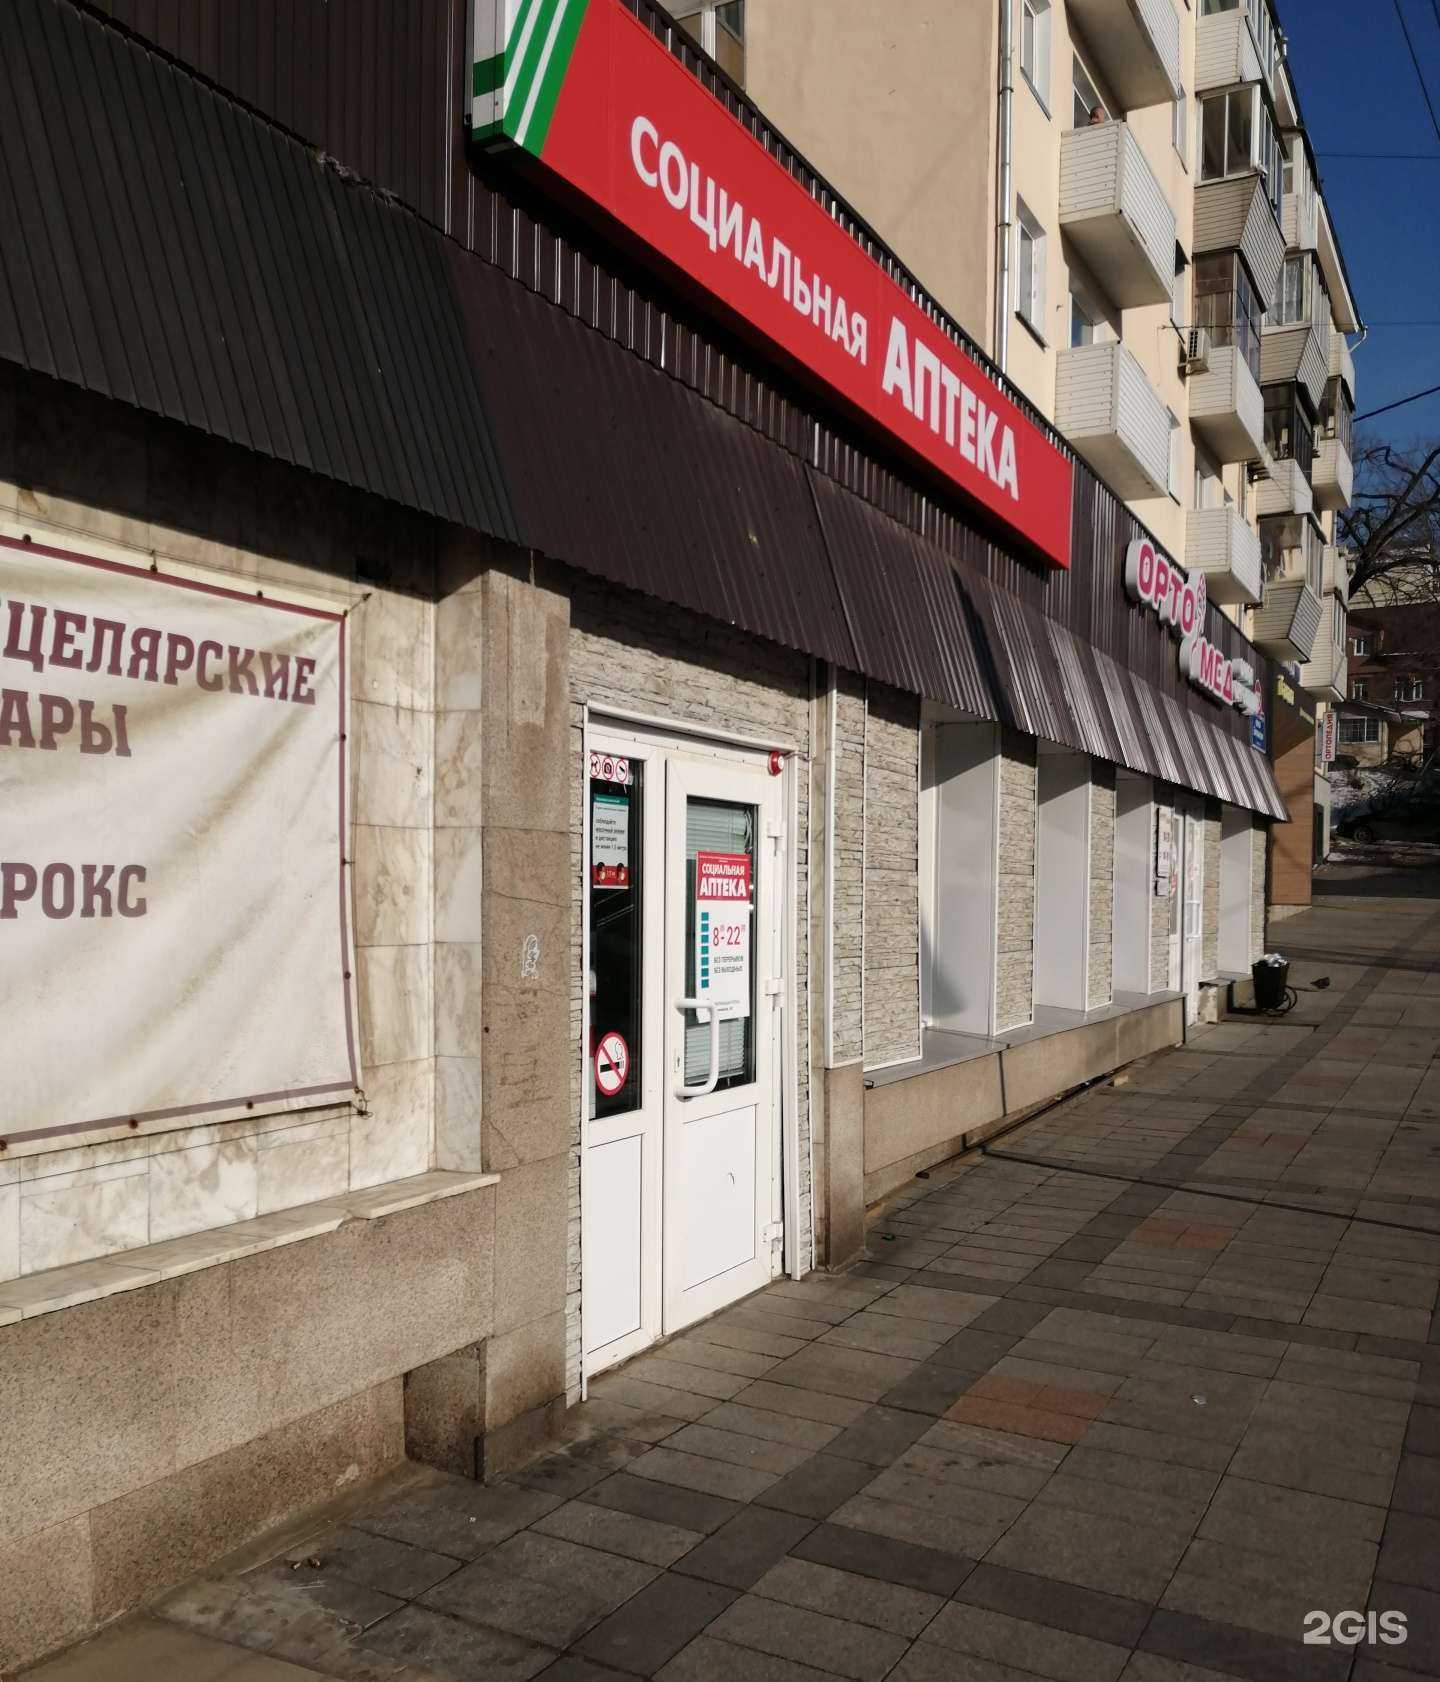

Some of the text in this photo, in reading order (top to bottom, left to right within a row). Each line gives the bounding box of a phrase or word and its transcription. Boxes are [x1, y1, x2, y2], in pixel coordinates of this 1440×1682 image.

[630, 115, 1020, 501] СОЦИАЛЬНАЯ АПТЕКА
[1138, 542, 1196, 635] ОРТО
[2, 599, 317, 706] ЦЕЛЯРСКИЕ
[0, 687, 133, 758] АРЫ
[0, 862, 148, 920] РОКС
[699, 877, 747, 897] АПТЕКА
[701, 862, 746, 877] СОЦИАЛЬНАЯ
